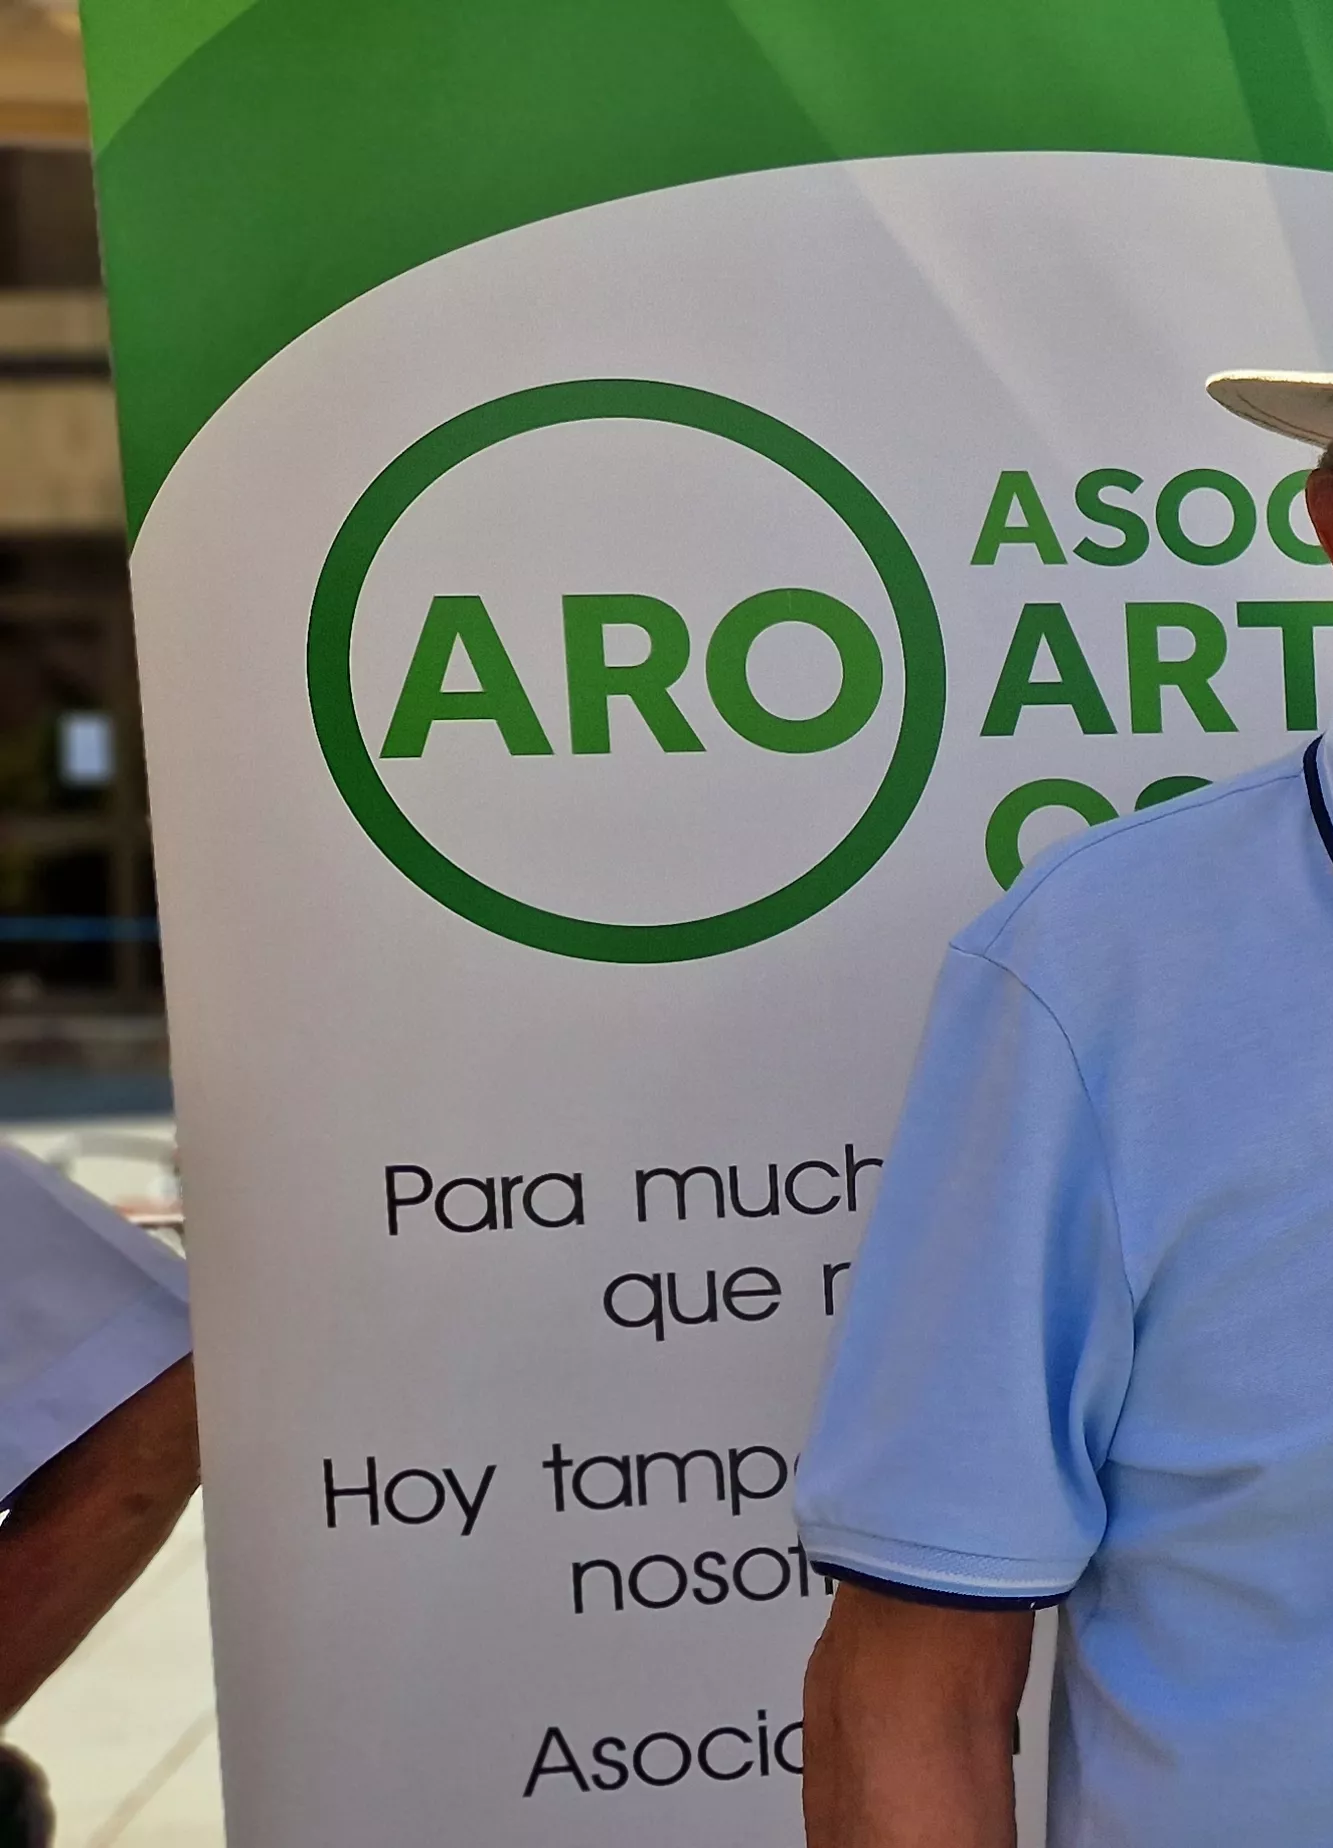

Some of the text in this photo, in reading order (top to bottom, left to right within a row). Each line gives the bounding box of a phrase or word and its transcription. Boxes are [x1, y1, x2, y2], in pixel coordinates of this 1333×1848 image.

[379, 587, 884, 760] ARO
[385, 1164, 585, 1236] Para
[603, 1265, 782, 1342] que
[322, 1443, 801, 1537] Hoy tamp
